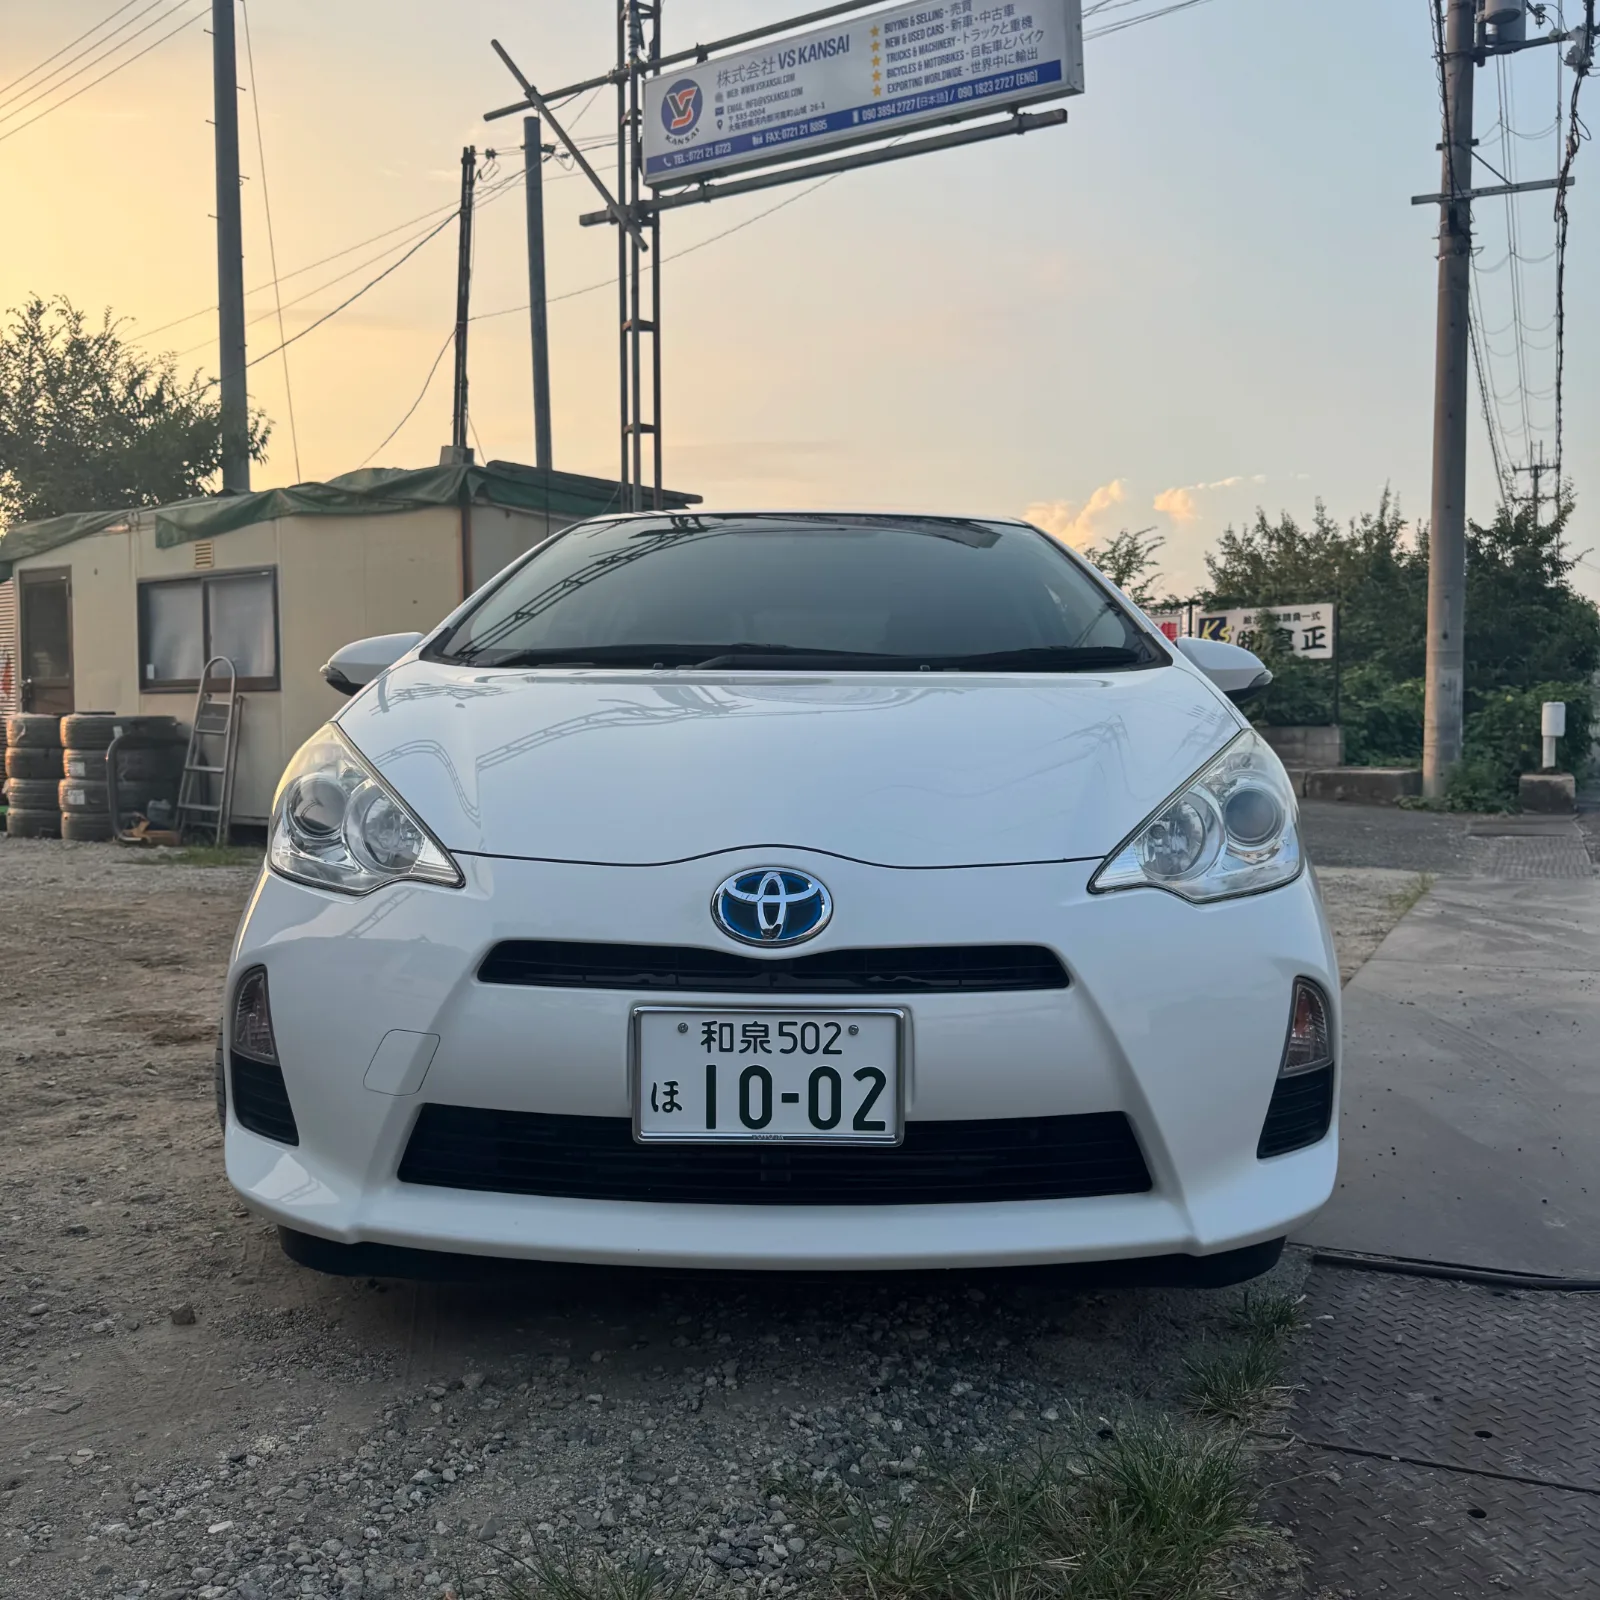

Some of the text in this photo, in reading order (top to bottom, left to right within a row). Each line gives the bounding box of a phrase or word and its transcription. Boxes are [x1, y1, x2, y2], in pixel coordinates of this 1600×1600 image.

[884, 17, 909, 34] BUYING
[916, 8, 944, 25] SELLING
[885, 35, 900, 49] NEW
[908, 28, 925, 43] USED
[926, 23, 944, 38] CARS
[886, 48, 911, 64] TRUCKS
[918, 36, 956, 55] MACHINERY
[716, 34, 850, 89] 株式会社 VS KANSAI
[886, 62, 917, 79] BICYCLES
[923, 49, 964, 69] MOTORBIKES
[887, 76, 923, 94] EXPORTING
[924, 66, 963, 85] WORLDWIDE
[862, 108, 877, 121] 090
[897, 99, 916, 113] 2727
[957, 85, 973, 99] 090
[994, 75, 1014, 91] 2727
[1016, 69, 1038, 86] (ENG)
[665, 127, 700, 146] KANSAI
[800, 123, 809, 135] 21
[705, 147, 713, 158] 21
[651, 1064, 887, 1131] ほ 10-02
